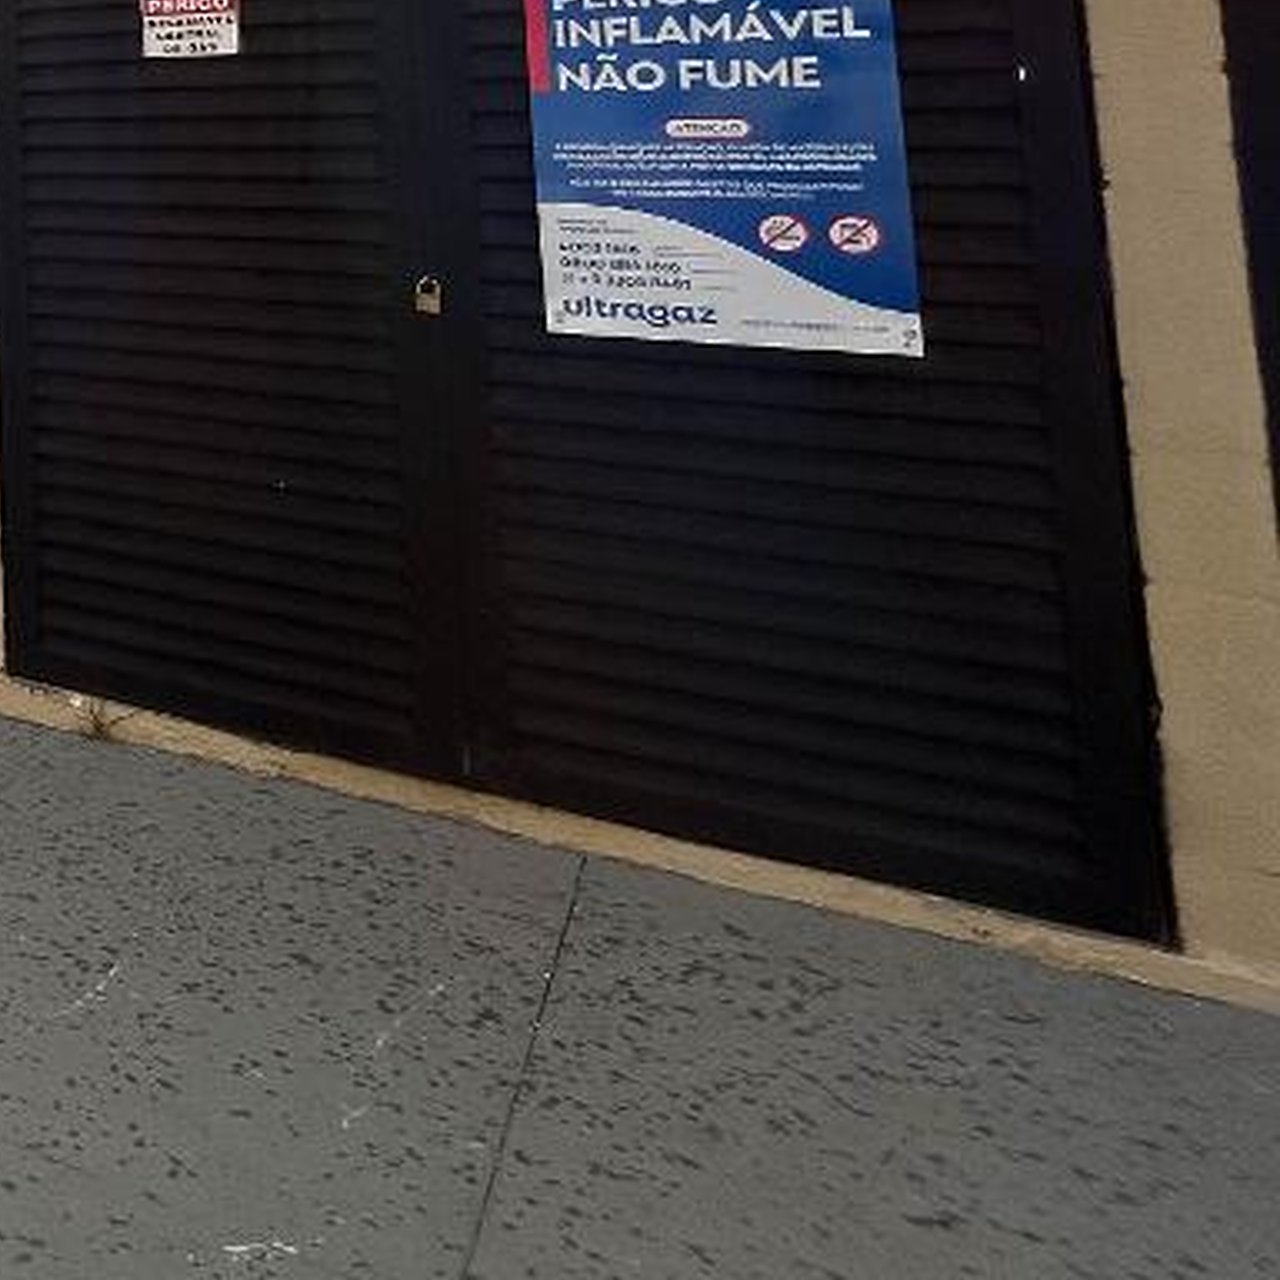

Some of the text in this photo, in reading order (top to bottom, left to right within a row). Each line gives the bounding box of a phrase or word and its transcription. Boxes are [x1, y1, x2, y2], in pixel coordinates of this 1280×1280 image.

[555, 1, 871, 48] INFLAMÁVEL
[558, 54, 822, 92] NÃO FUME
[563, 295, 717, 328] ultragaz
